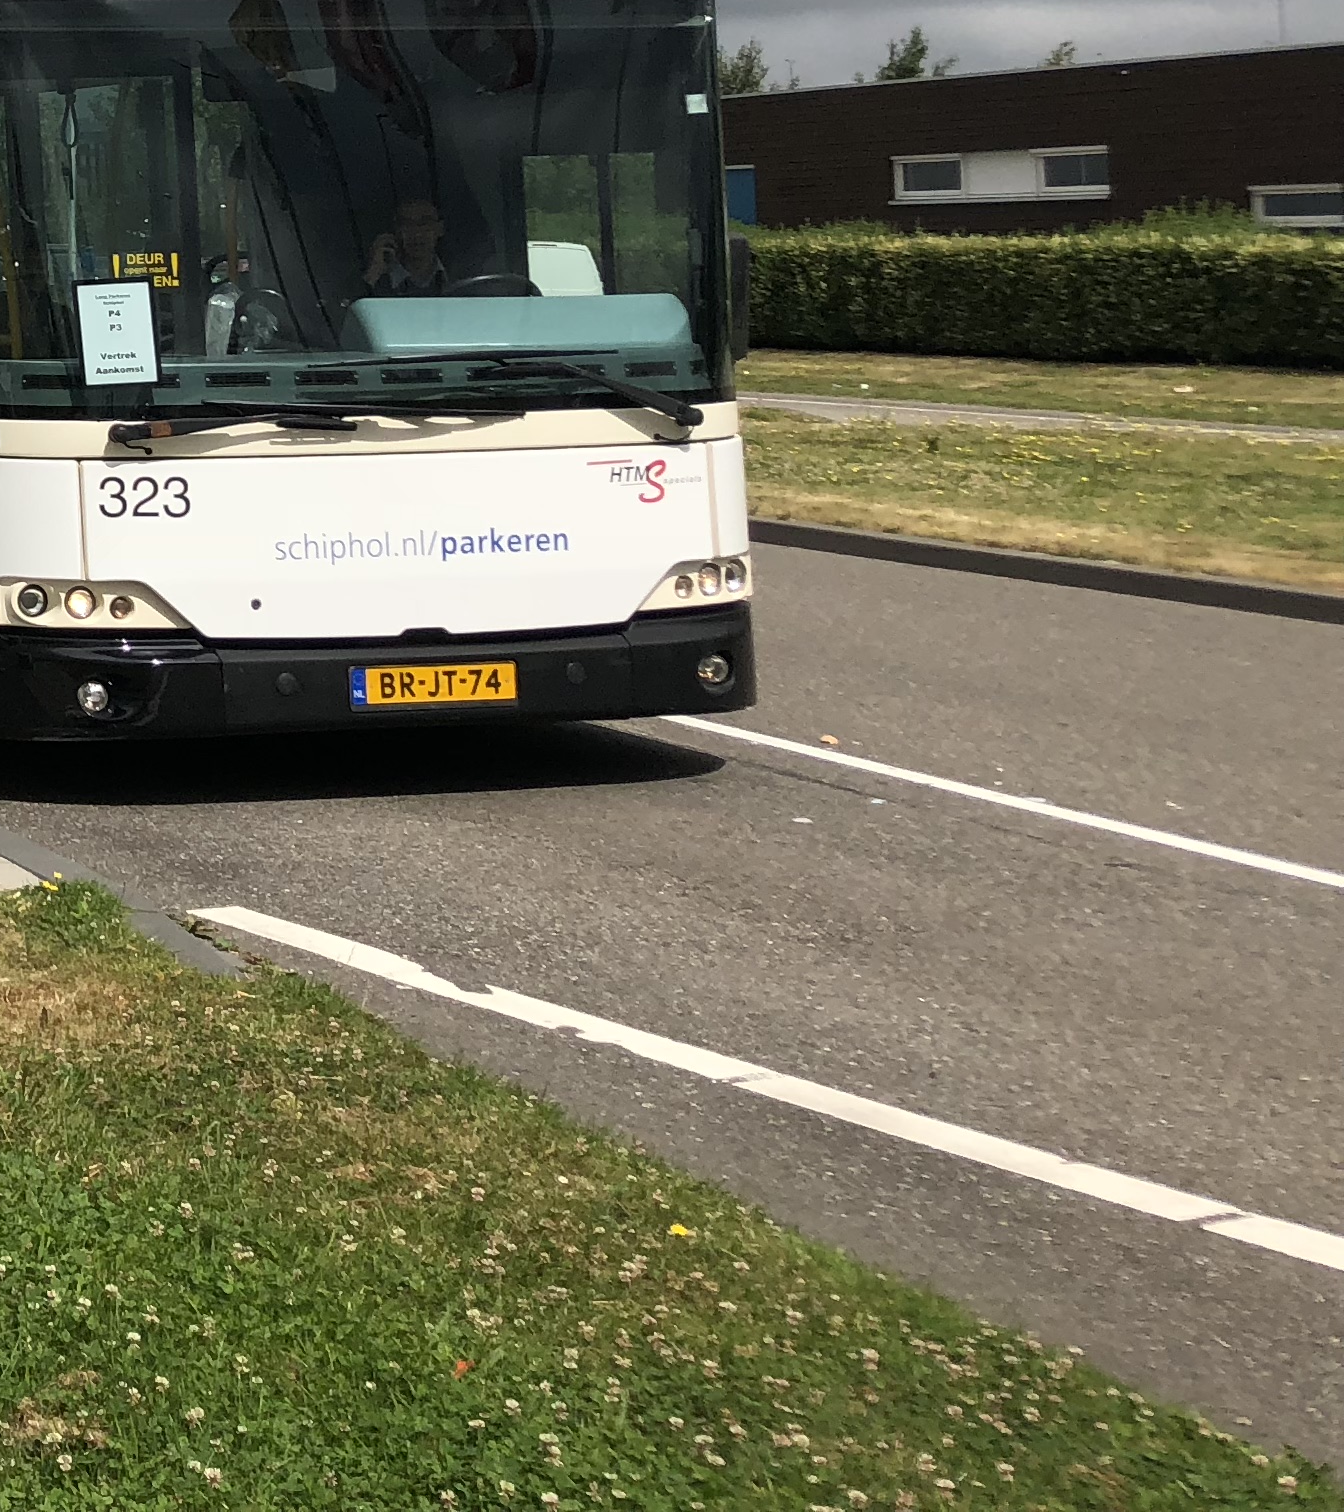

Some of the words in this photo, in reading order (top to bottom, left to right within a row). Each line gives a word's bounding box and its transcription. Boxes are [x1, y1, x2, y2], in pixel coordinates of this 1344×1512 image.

[126, 252, 164, 265] DEUR
[108, 309, 121, 317] P4
[109, 323, 123, 331] P3
[100, 351, 137, 360] Vertrek
[95, 365, 145, 375] Aankomst
[98, 476, 192, 519] 323
[275, 527, 569, 565] schiphol.nl/parkeren
[379, 668, 502, 699] BR-JT-74
[353, 689, 366, 699] NL
